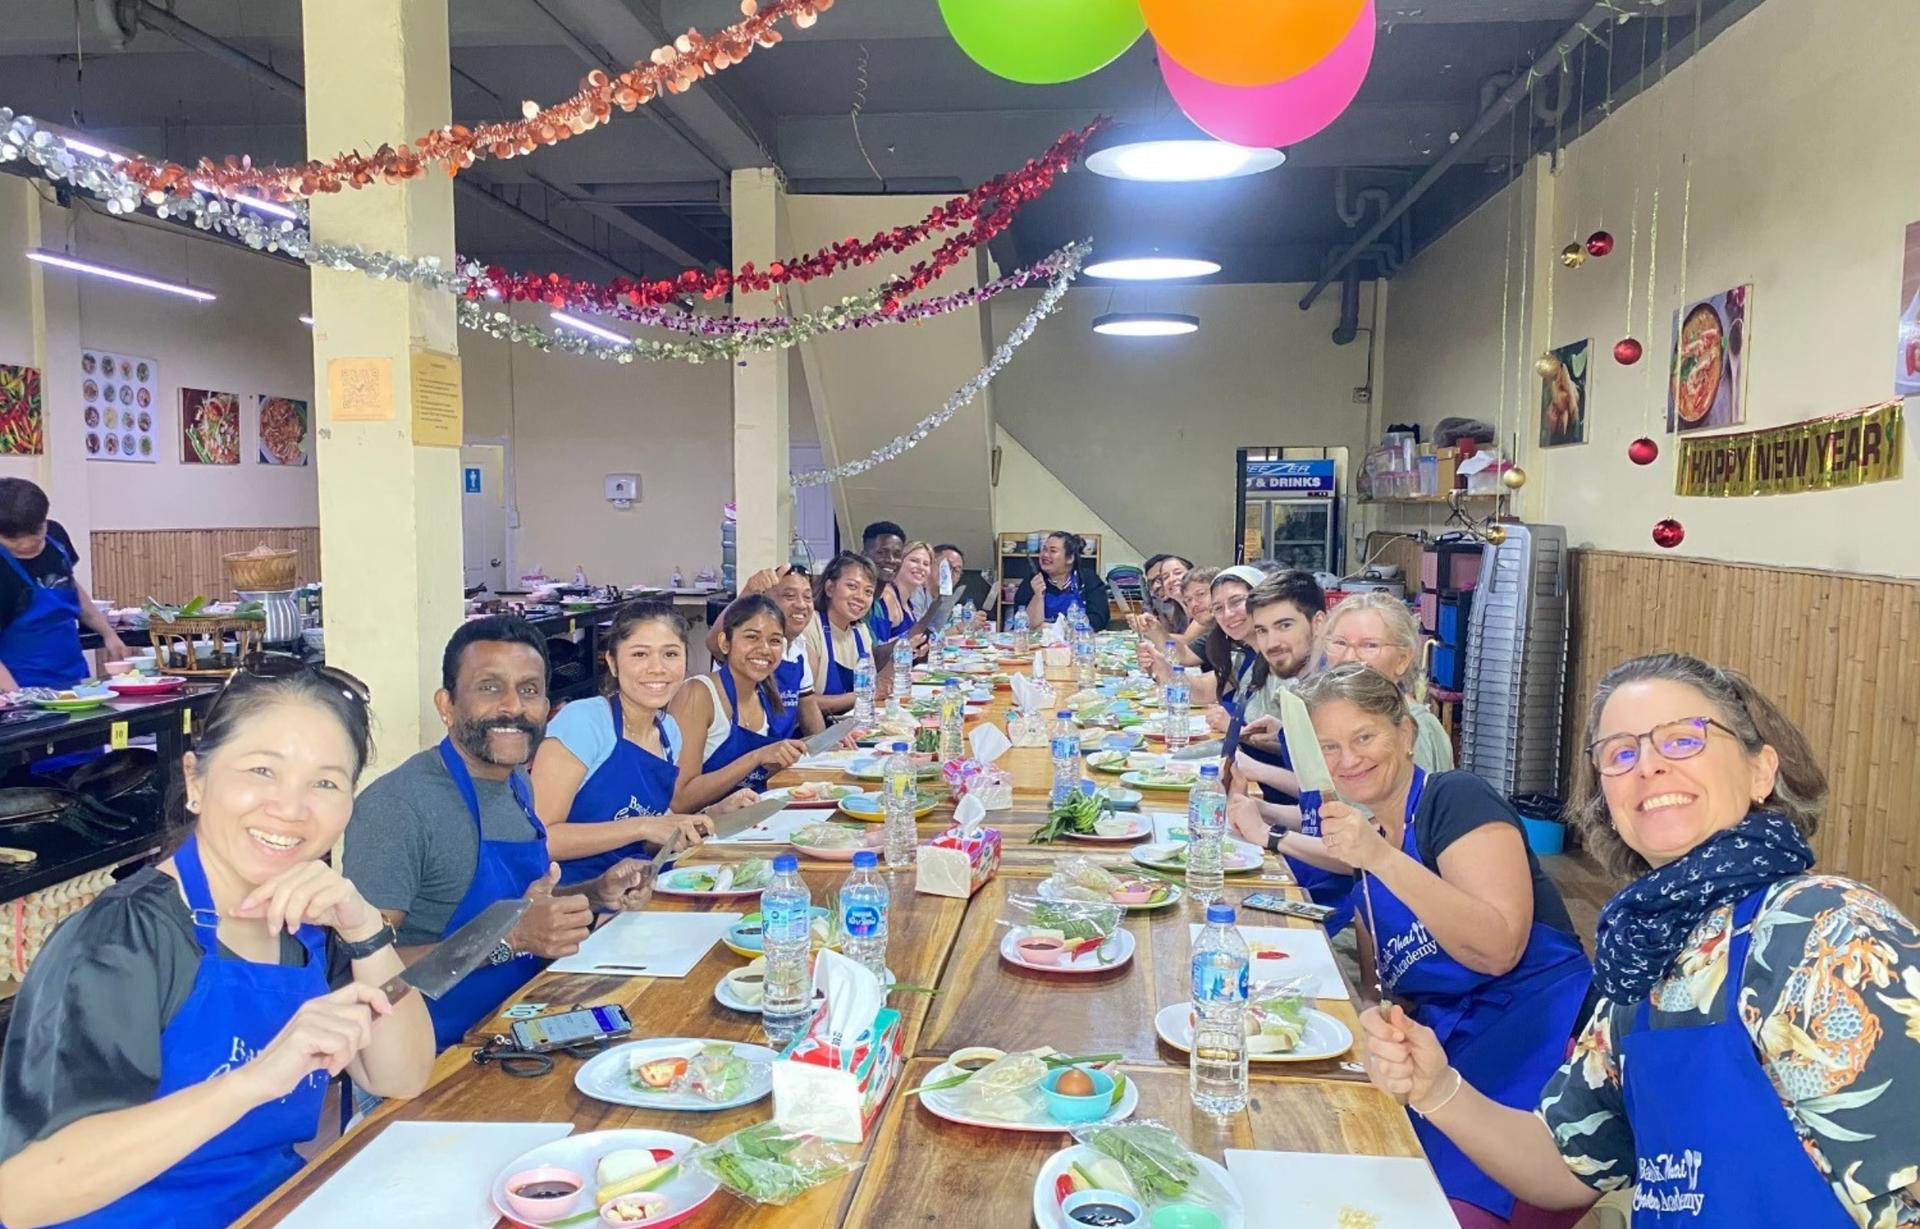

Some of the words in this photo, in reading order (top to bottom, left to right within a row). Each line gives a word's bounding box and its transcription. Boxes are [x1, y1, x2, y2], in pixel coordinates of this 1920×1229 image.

[1691, 446, 1751, 483] HAPPY
[1755, 437, 1809, 480] NEW
[1815, 421, 1882, 473] YEAR
[1247, 463, 1312, 476] EEZER
[1270, 477, 1321, 488] DRINKS
[1387, 929, 1415, 955] Thai
[1656, 1153, 1687, 1182] Thai
